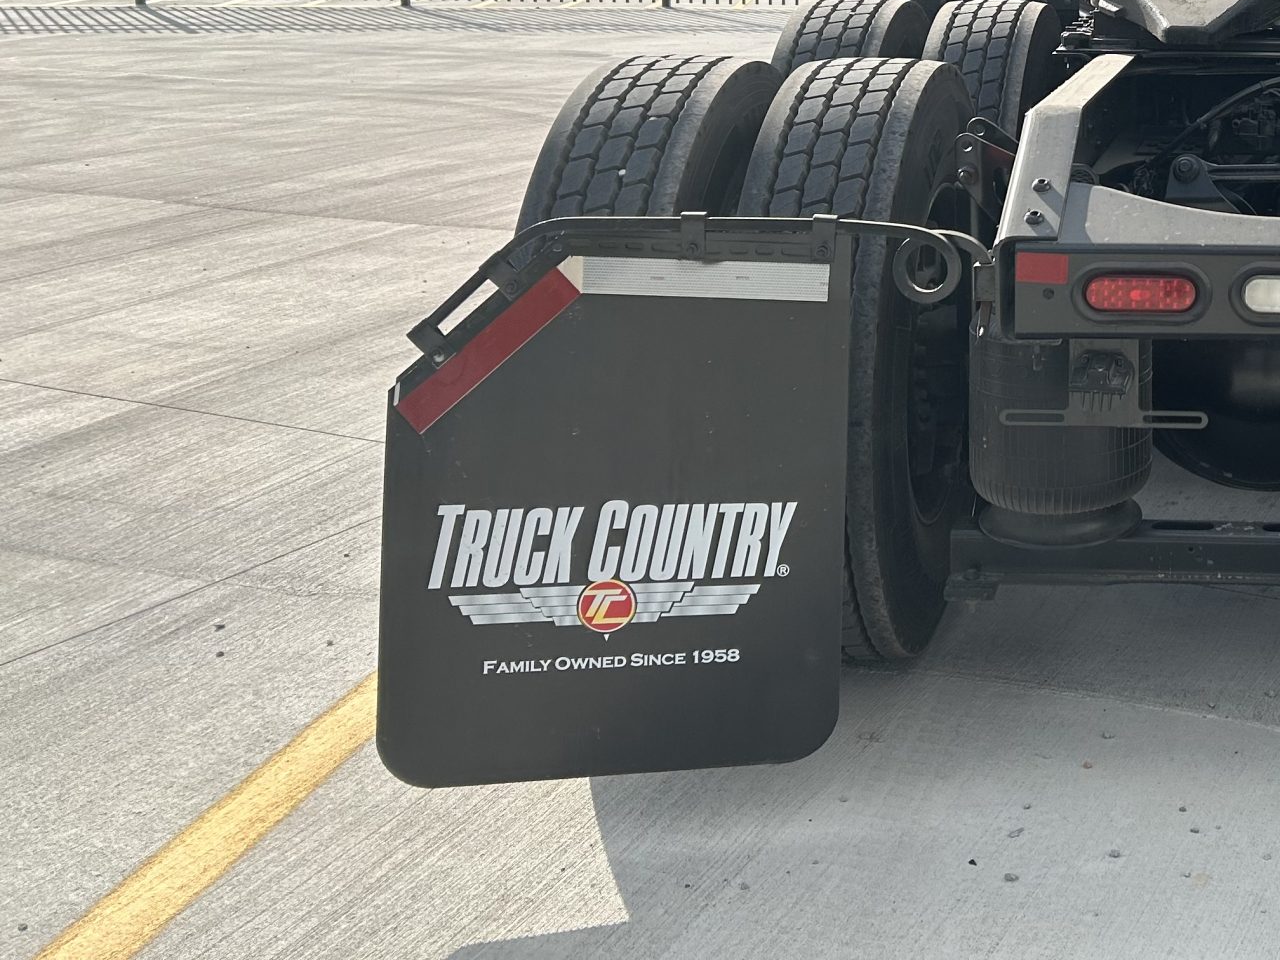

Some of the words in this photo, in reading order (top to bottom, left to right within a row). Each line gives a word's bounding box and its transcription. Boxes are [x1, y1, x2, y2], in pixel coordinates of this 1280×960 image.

[427, 504, 585, 590] TRUCK
[482, 658, 553, 675] FAMILY
[555, 655, 627, 671] OWNED
[630, 652, 687, 667] SINCE
[692, 648, 741, 664] 1958
